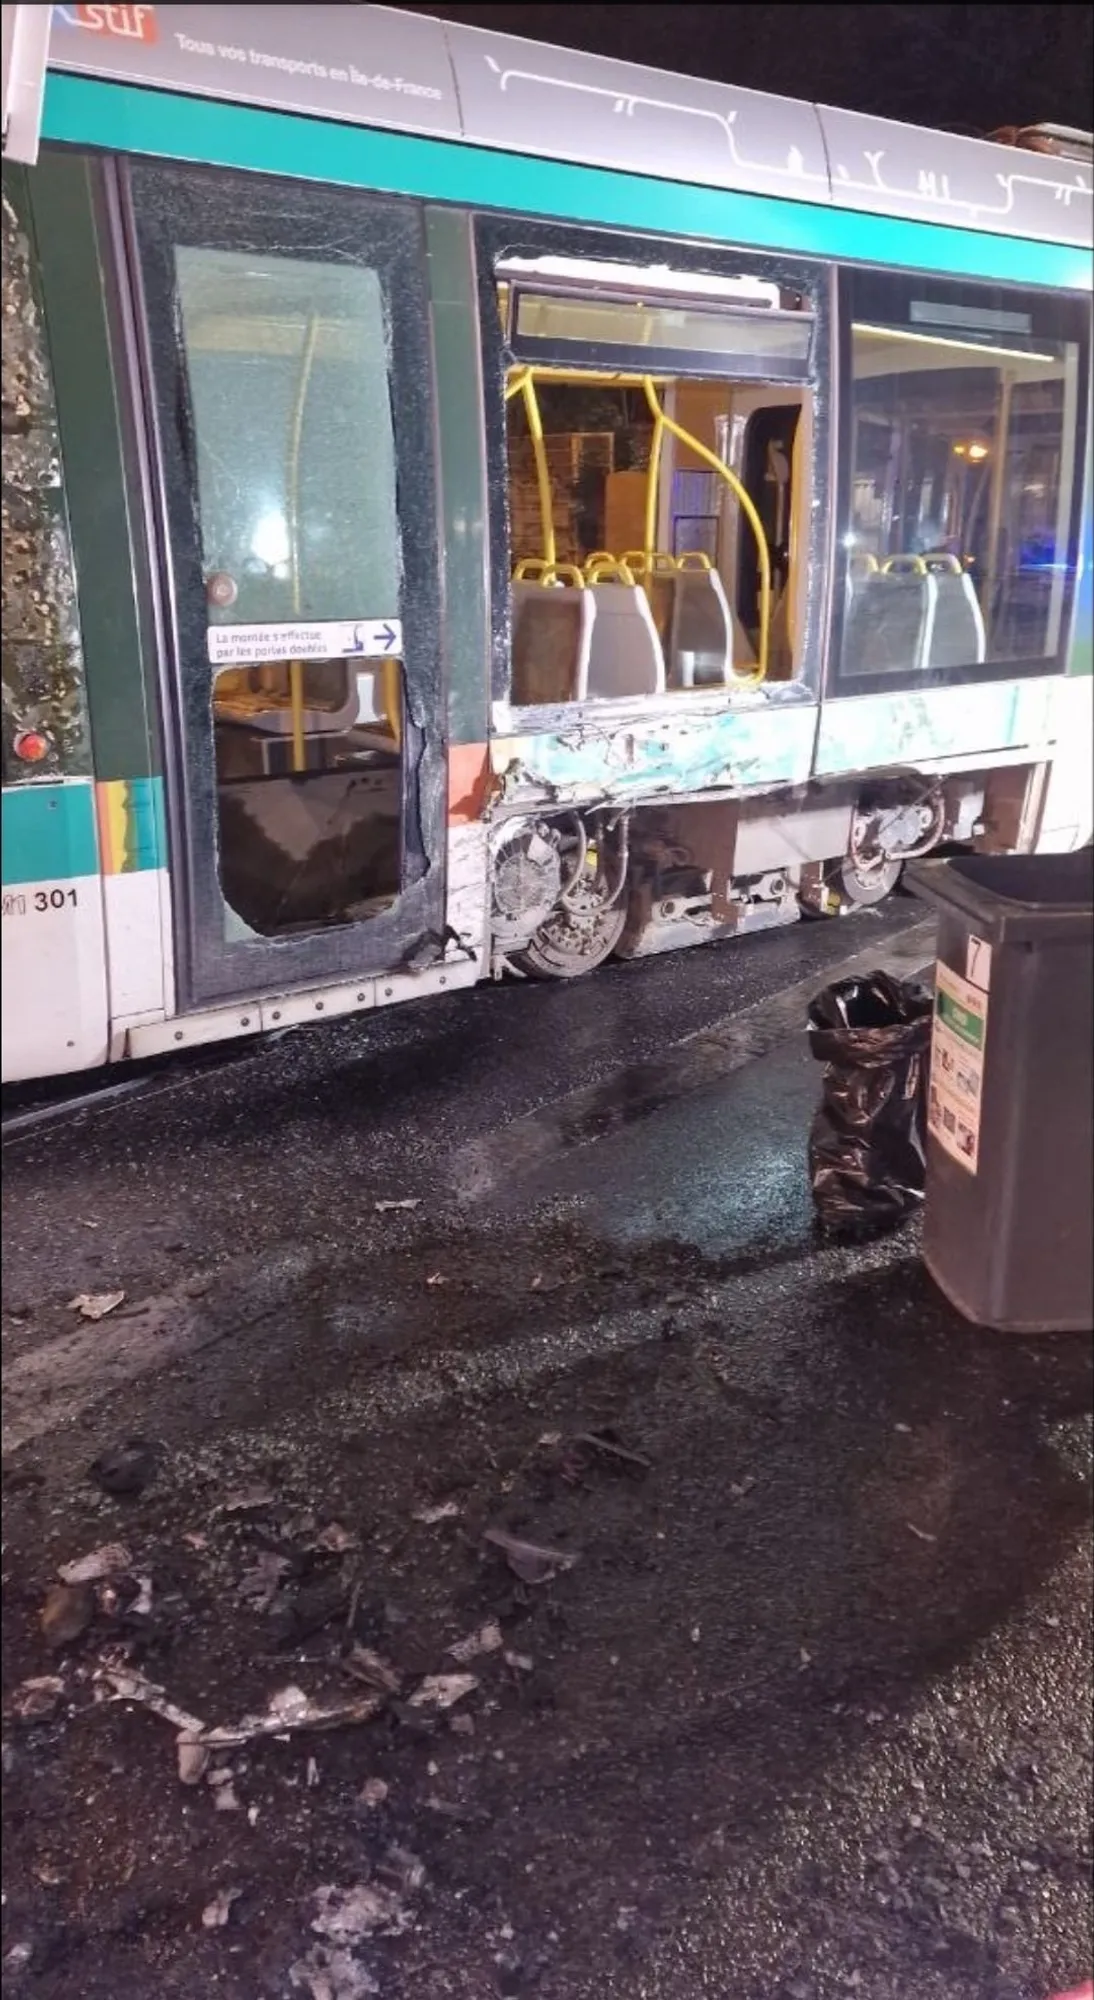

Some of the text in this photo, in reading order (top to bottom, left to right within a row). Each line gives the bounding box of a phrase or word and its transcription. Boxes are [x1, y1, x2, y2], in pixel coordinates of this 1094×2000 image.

[174, 32, 216, 57] Tous
[217, 45, 246, 62] vos
[248, 48, 328, 78] transports
[329, 67, 348, 82] en
[216, 633, 229, 644] La
[216, 647, 234, 659] par
[236, 646, 251, 656] les
[34, 888, 78, 912] 301
[971, 937, 982, 977] 7
